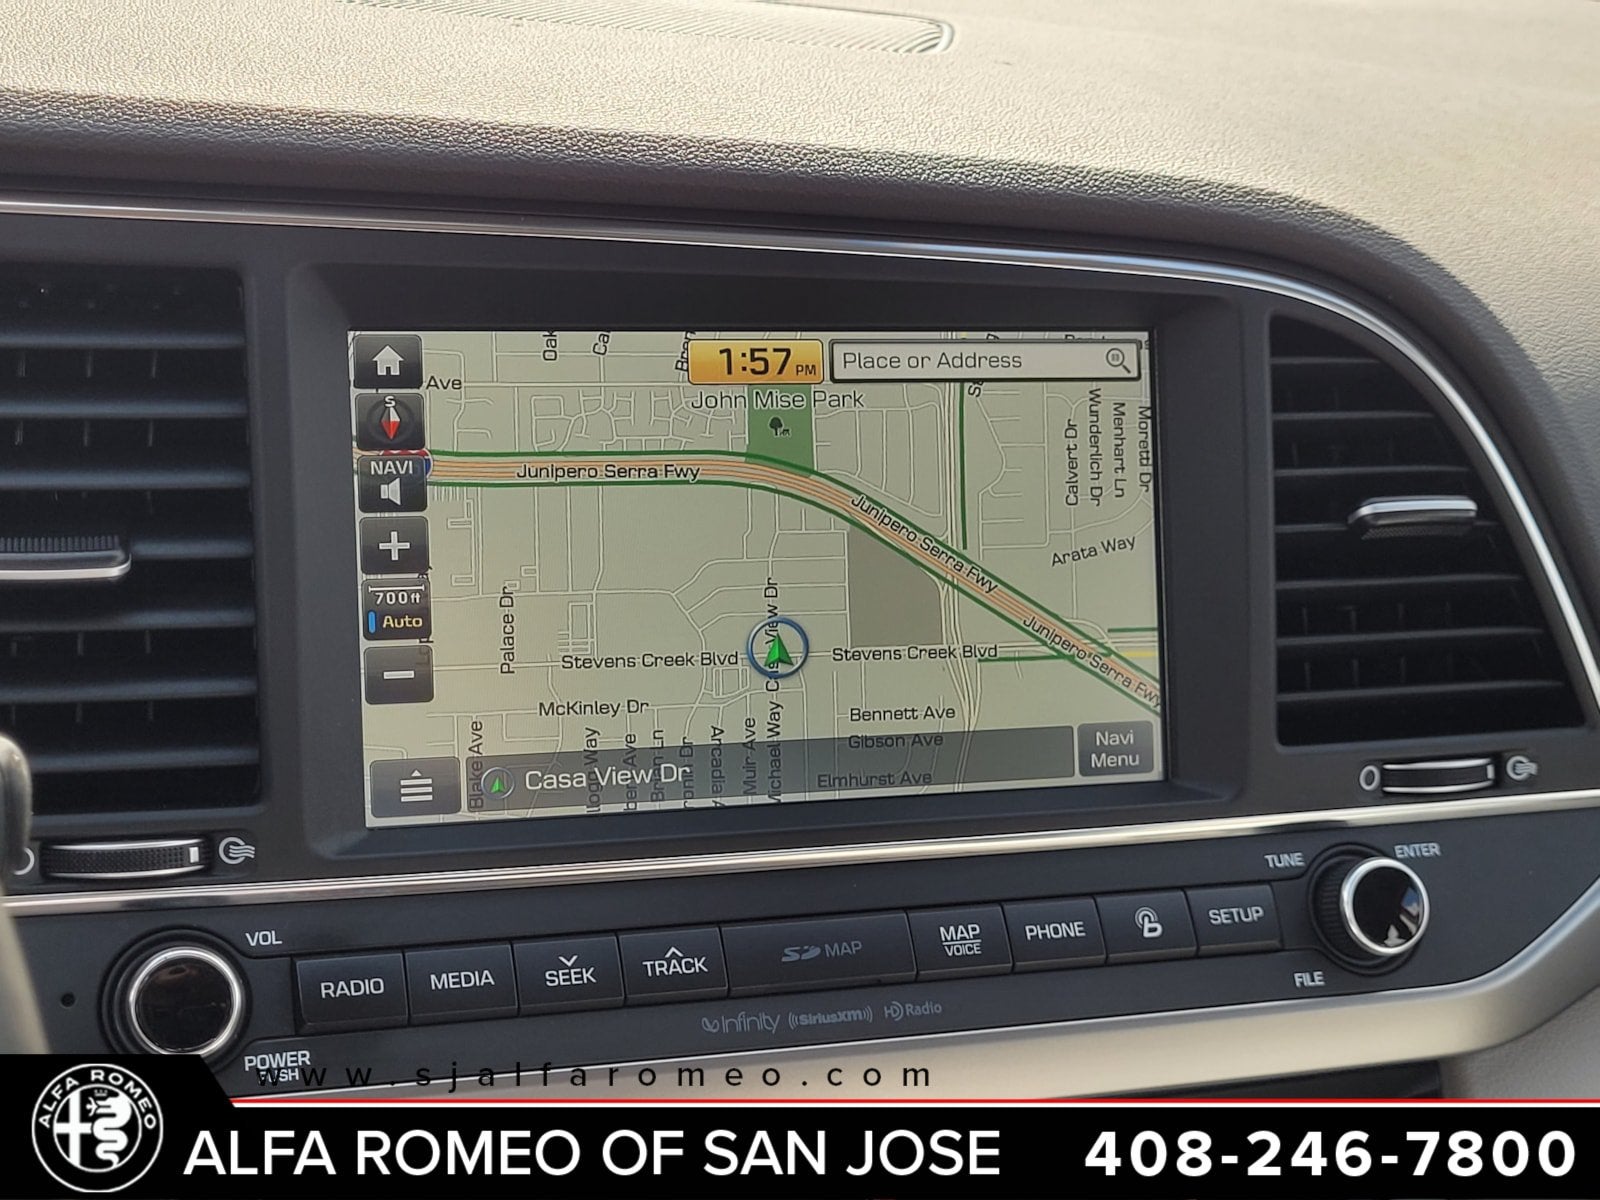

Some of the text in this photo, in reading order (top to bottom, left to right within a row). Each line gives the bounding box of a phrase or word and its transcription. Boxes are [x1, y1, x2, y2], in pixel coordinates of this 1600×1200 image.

[718, 347, 817, 377] 1:57 PM
[842, 352, 1023, 370] Place or Address
[425, 375, 463, 390] Ave
[691, 389, 866, 409] John Mise Park
[1088, 387, 1103, 507] Wunderlich Dr
[1112, 401, 1127, 499] Menhart Ln
[370, 459, 413, 475] NAVI
[516, 462, 701, 483] Junipero Serra Fwy
[1064, 418, 1079, 507] Calvert Dr
[1138, 472, 1152, 494] Dr
[850, 494, 999, 594] Junipero Serra Fwy
[1052, 535, 1137, 567] Arata Way
[764, 577, 779, 599] Dr
[382, 615, 424, 629] Auto
[500, 586, 515, 675] Palace Dr
[561, 651, 739, 670] Stevens Creek Blvd
[831, 644, 998, 663] Stevens Creek Blvd
[1022, 615, 1087, 661] Junipero
[1089, 654, 1133, 689] Serra
[538, 699, 650, 718] McKinley Dr
[849, 705, 956, 722] Bennett Ave
[766, 700, 784, 739] Way
[583, 726, 601, 766] Way
[680, 736, 694, 758] Dr
[848, 733, 944, 750] Gibson Ave
[1095, 730, 1134, 746] Navi
[622, 733, 637, 768] Ave
[711, 725, 726, 795] Arcadia
[742, 717, 757, 795] Muir Ave
[1091, 751, 1140, 769] Menu
[468, 720, 484, 810] Blake Ave
[650, 729, 665, 802] Brian Ln
[524, 763, 691, 791] Casa View Dr
[816, 771, 932, 789] Elmhurst Ave
[1264, 852, 1305, 869] TUNE
[1394, 842, 1441, 859] ENTER
[1208, 905, 1265, 926] SETUP
[245, 929, 283, 947] VOL
[939, 923, 981, 941] MAP
[1024, 920, 1086, 941] PHONE
[824, 940, 863, 958] MAP
[943, 942, 982, 957] VOICE
[544, 966, 597, 987] SEEK
[642, 956, 709, 978] TRACK
[319, 977, 385, 999] RADIO
[429, 969, 496, 991] MEDIA
[1293, 970, 1326, 988] FILE
[904, 1000, 943, 1017] Radio
[243, 1049, 312, 1072] POWER
